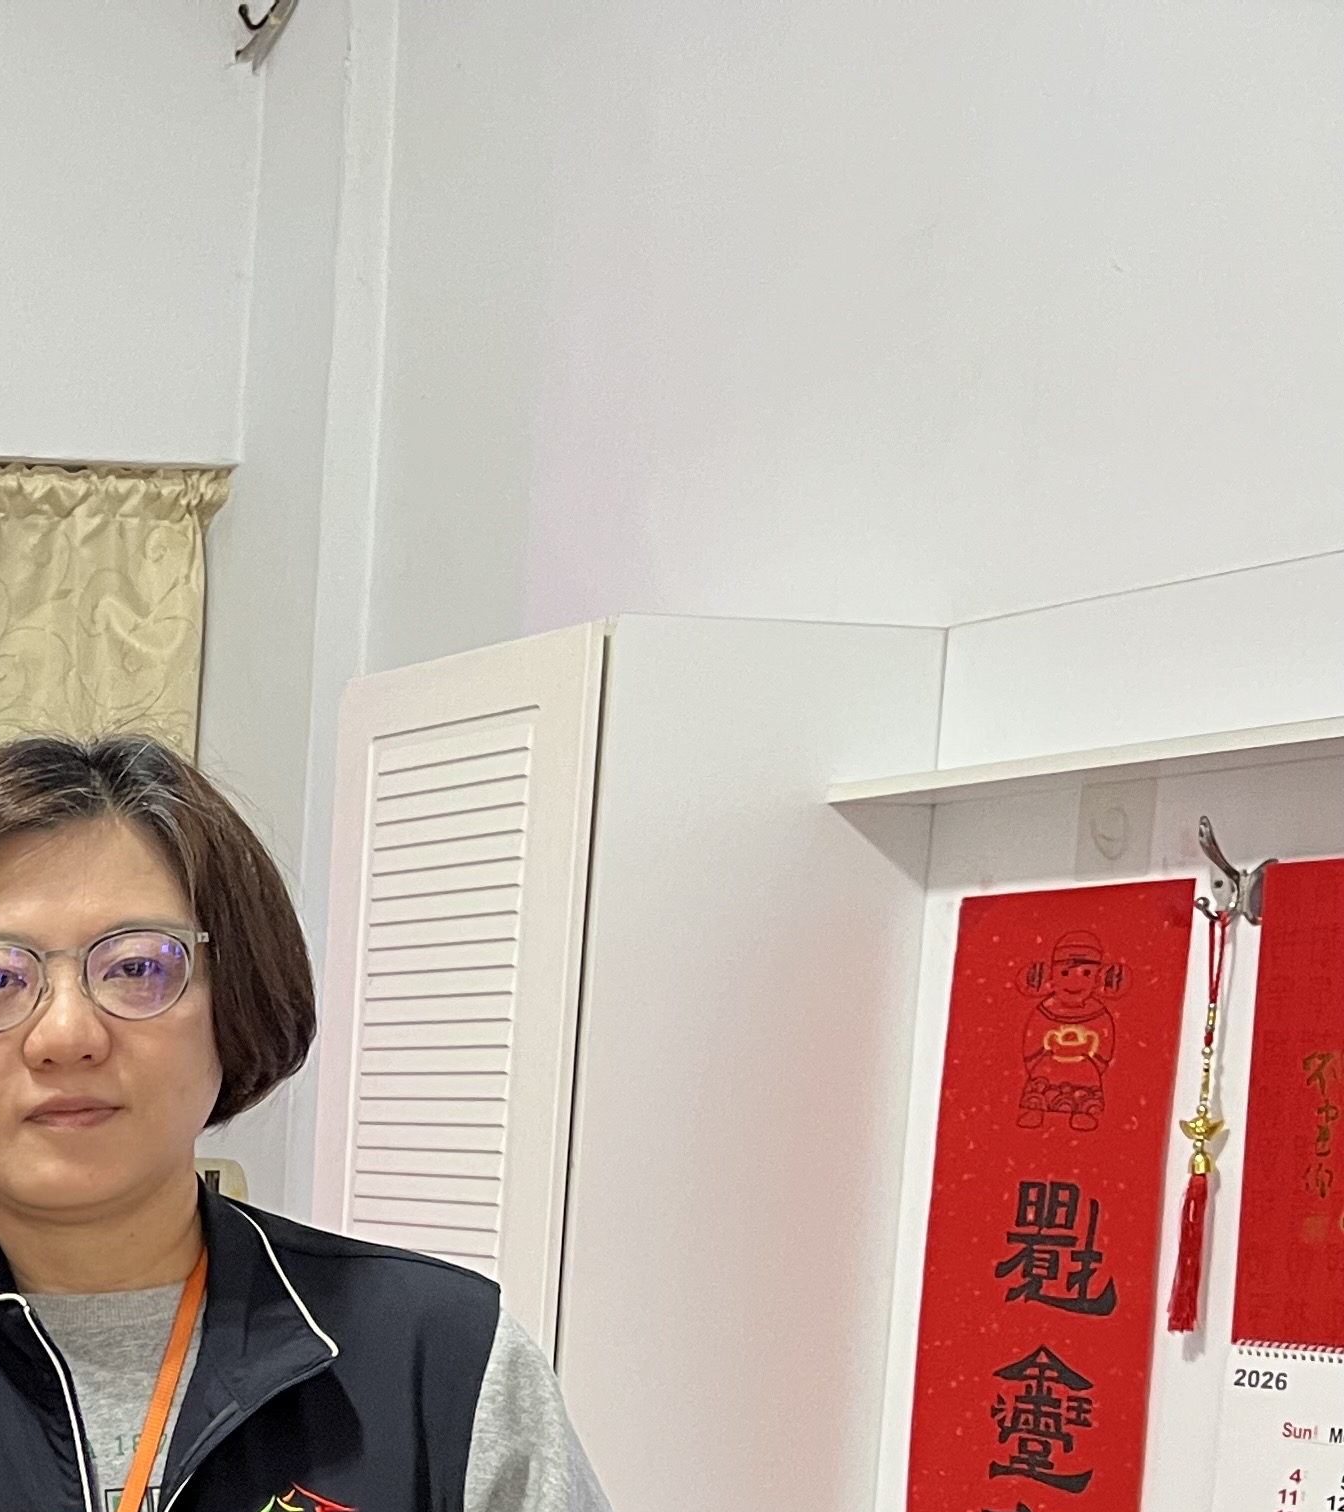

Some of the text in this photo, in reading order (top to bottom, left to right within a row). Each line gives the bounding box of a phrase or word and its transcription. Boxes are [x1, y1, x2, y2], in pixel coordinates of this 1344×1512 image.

[1233, 1368, 1288, 1391] 2026
[1282, 1422, 1312, 1440] Sun
[1289, 1468, 1302, 1484] 4
[1278, 1488, 1298, 1505] 11
